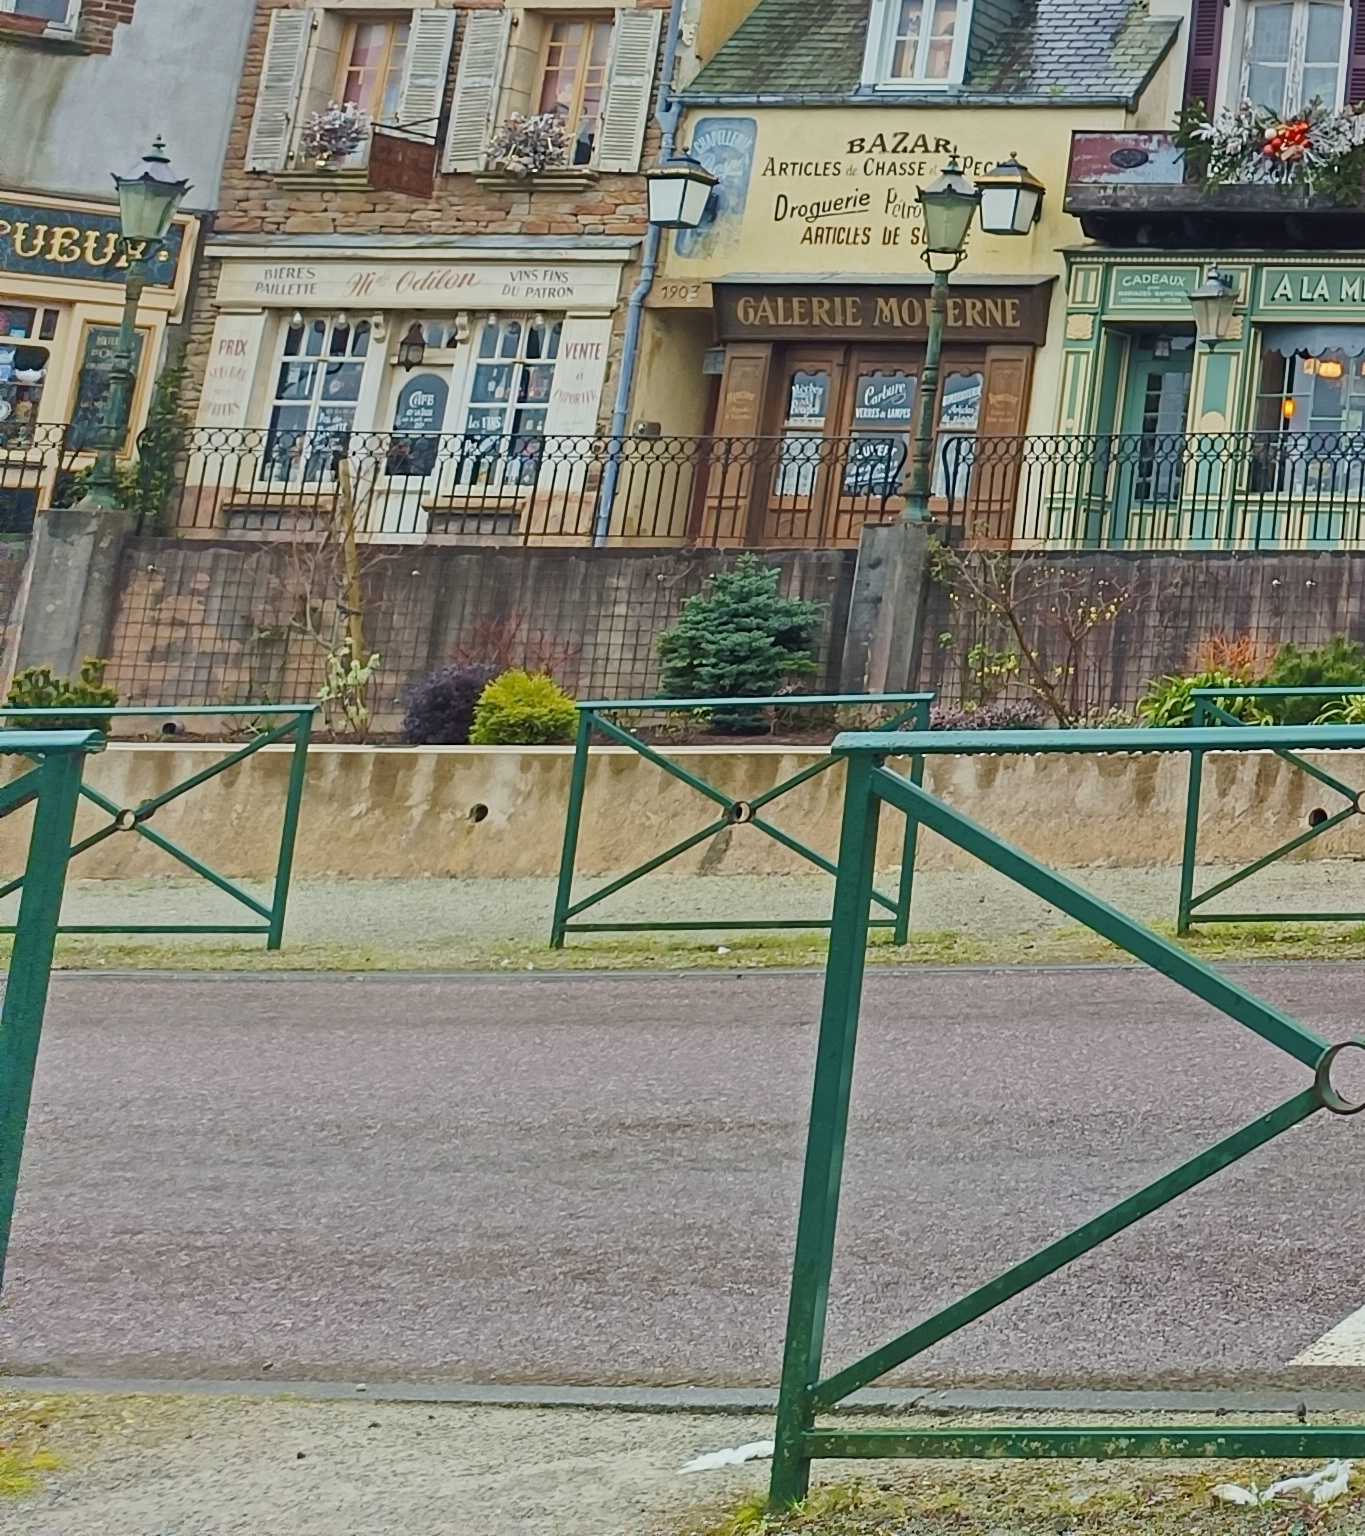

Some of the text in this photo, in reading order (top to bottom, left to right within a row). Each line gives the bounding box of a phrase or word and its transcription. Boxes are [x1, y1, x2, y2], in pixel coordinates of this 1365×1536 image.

[847, 132, 951, 154] BAZAR
[762, 157, 842, 177] ARTICLES
[863, 157, 926, 176] CHASSE
[774, 188, 870, 223] Droguerie
[800, 226, 872, 245] ARTICLES
[882, 226, 900, 245] DE
[395, 269, 482, 294] Odilon
[510, 269, 570, 284] VINS FINS
[1122, 273, 1186, 287] CADEAUX
[254, 282, 318, 296] PAILLETTE
[502, 284, 574, 299] DU PATRON
[1271, 273, 1293, 301] A
[1300, 274, 1330, 302] LA
[737, 295, 862, 328] GALERIE
[218, 339, 249, 357] PRIX
[565, 342, 603, 360] VENTE
[864, 383, 907, 405] Carbure
[856, 407, 880, 418] VERRES
[887, 407, 911, 418] LAMPES
